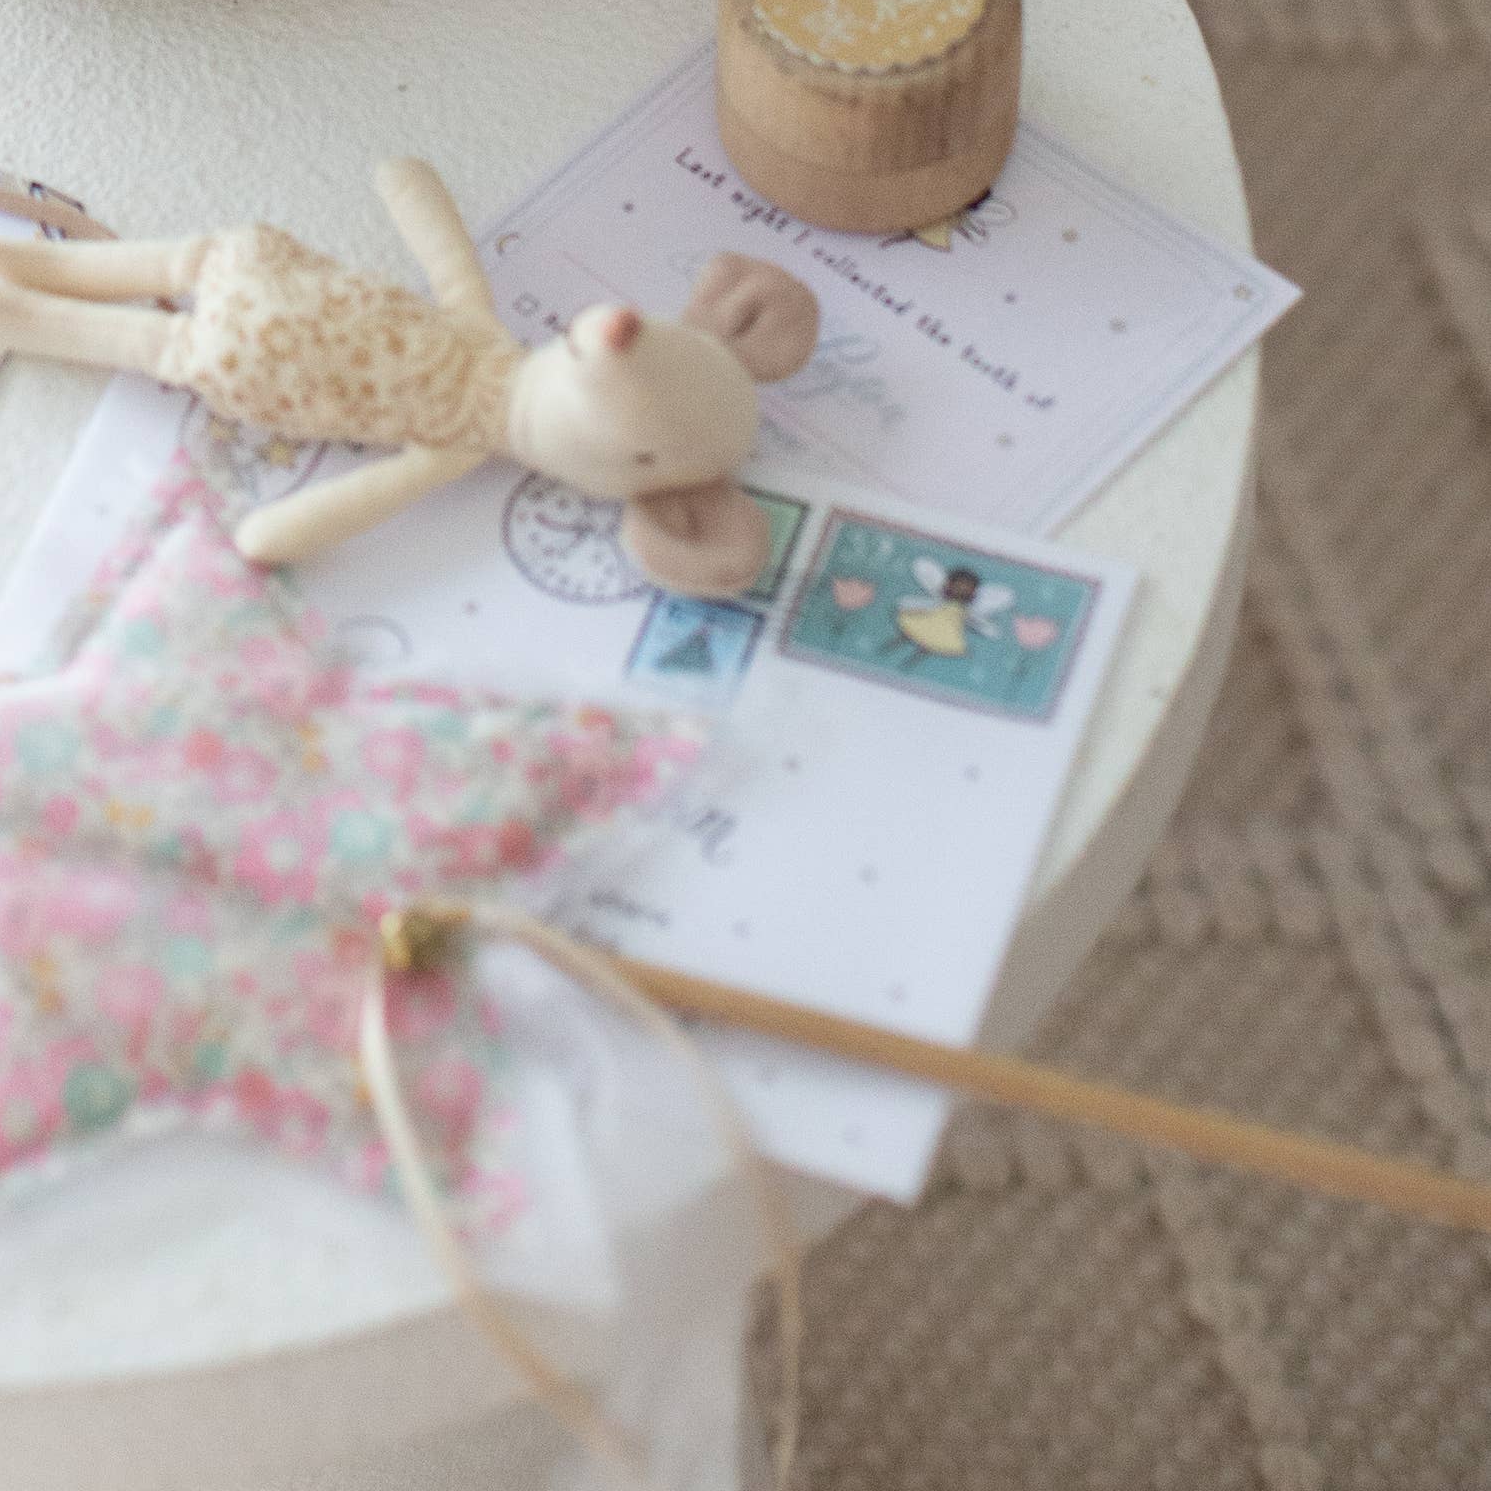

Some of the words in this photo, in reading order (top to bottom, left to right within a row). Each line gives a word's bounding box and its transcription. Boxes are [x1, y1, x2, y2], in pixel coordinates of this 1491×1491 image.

[730, 189, 792, 233] night
[813, 245, 915, 317] collected
[916, 315, 953, 347] the
[961, 344, 1021, 392] tooth
